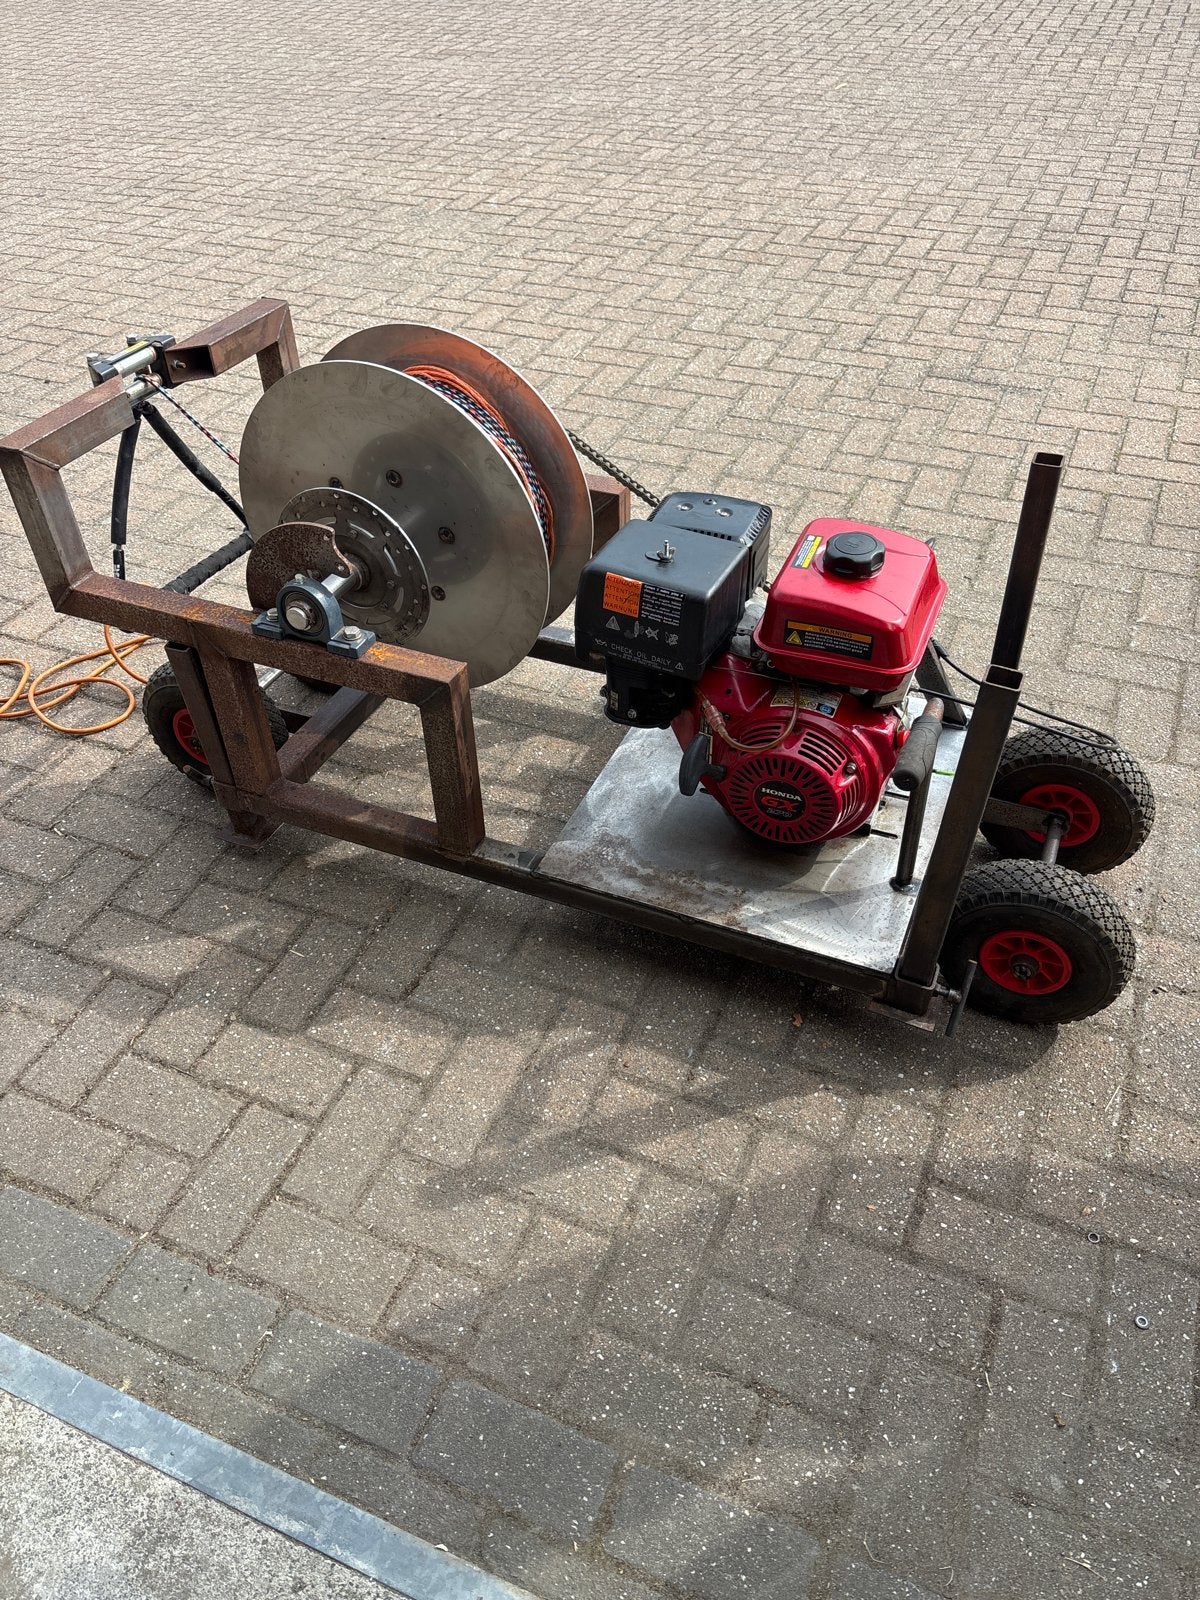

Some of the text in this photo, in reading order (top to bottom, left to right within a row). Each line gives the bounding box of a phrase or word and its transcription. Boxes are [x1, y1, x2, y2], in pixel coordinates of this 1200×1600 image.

[605, 584, 640, 598] ATTENTION
[605, 593, 639, 606] ATTENTION
[604, 601, 638, 614] WARNUNG
[819, 627, 853, 638] WARNING
[611, 643, 633, 655] CHECK
[636, 651, 647, 660] OIL
[651, 655, 671, 666] DAILY
[761, 787, 803, 802] HONDA
[761, 796, 799, 813] GX
